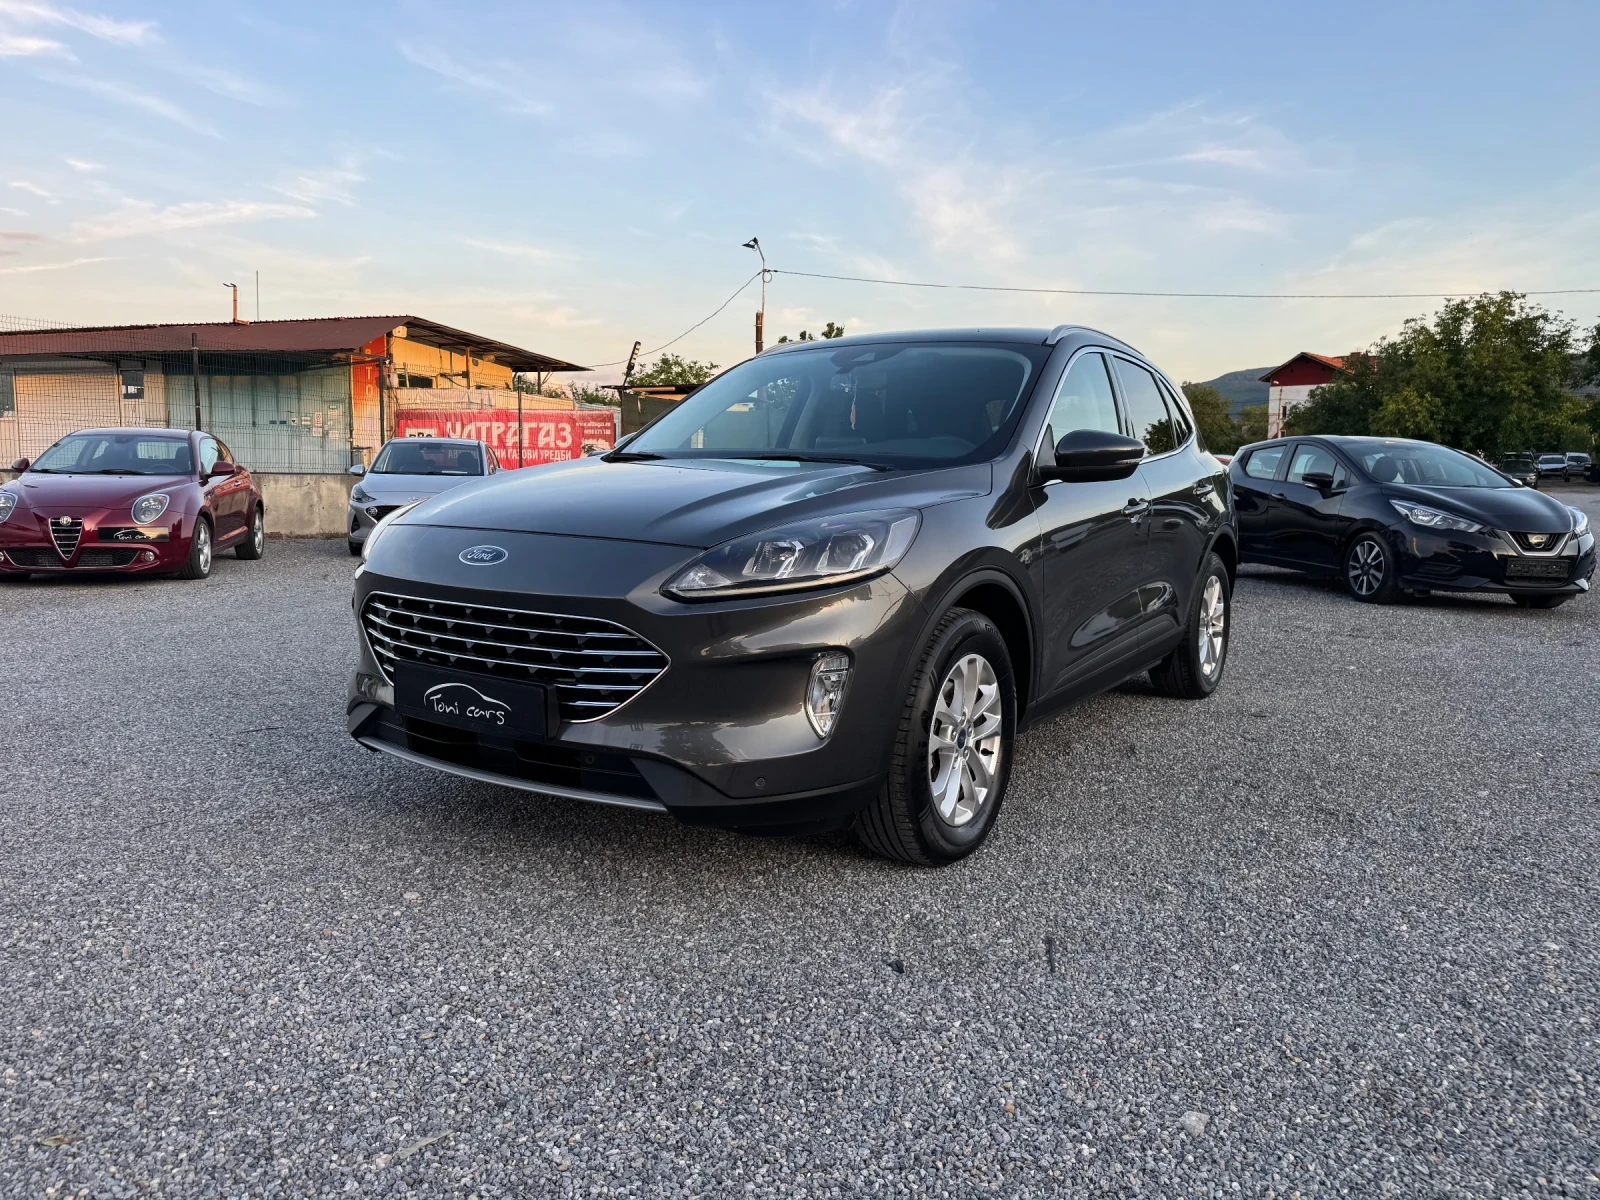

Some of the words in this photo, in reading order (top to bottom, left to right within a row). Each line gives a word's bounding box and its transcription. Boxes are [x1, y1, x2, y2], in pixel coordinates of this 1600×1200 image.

[508, 449, 538, 460] ГАОВИ
[539, 449, 572, 462] УРЕДБИ
[467, 547, 496, 560] Ford
[430, 693, 459, 715] Toni
[466, 706, 505, 725] cars
